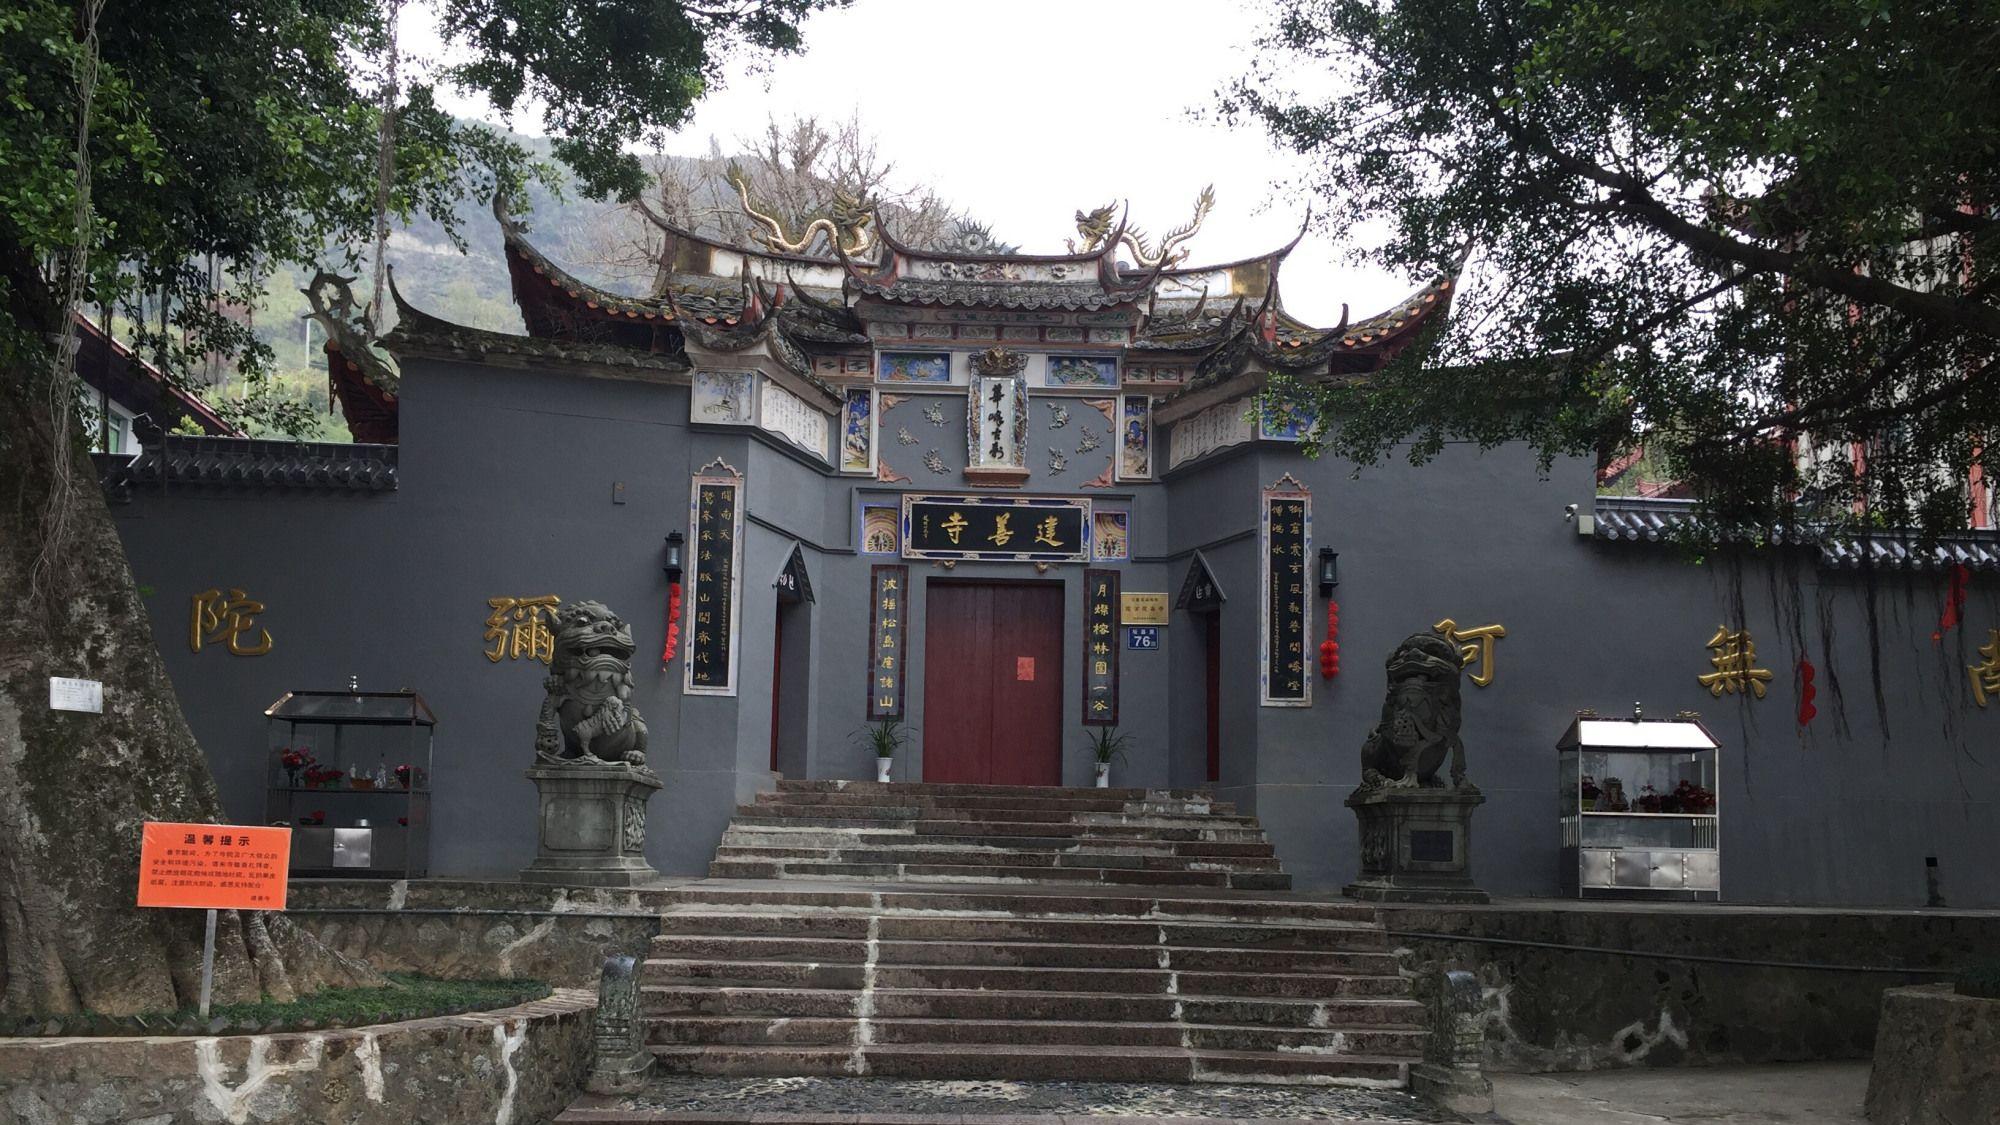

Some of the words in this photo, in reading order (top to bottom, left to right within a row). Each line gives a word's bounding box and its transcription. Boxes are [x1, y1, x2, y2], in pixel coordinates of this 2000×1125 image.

[940, 512, 1064, 546] 建善寺
[191, 588, 273, 656] 陀
[1698, 624, 1774, 697] 無
[184, 833, 250, 847] 温馨提示
